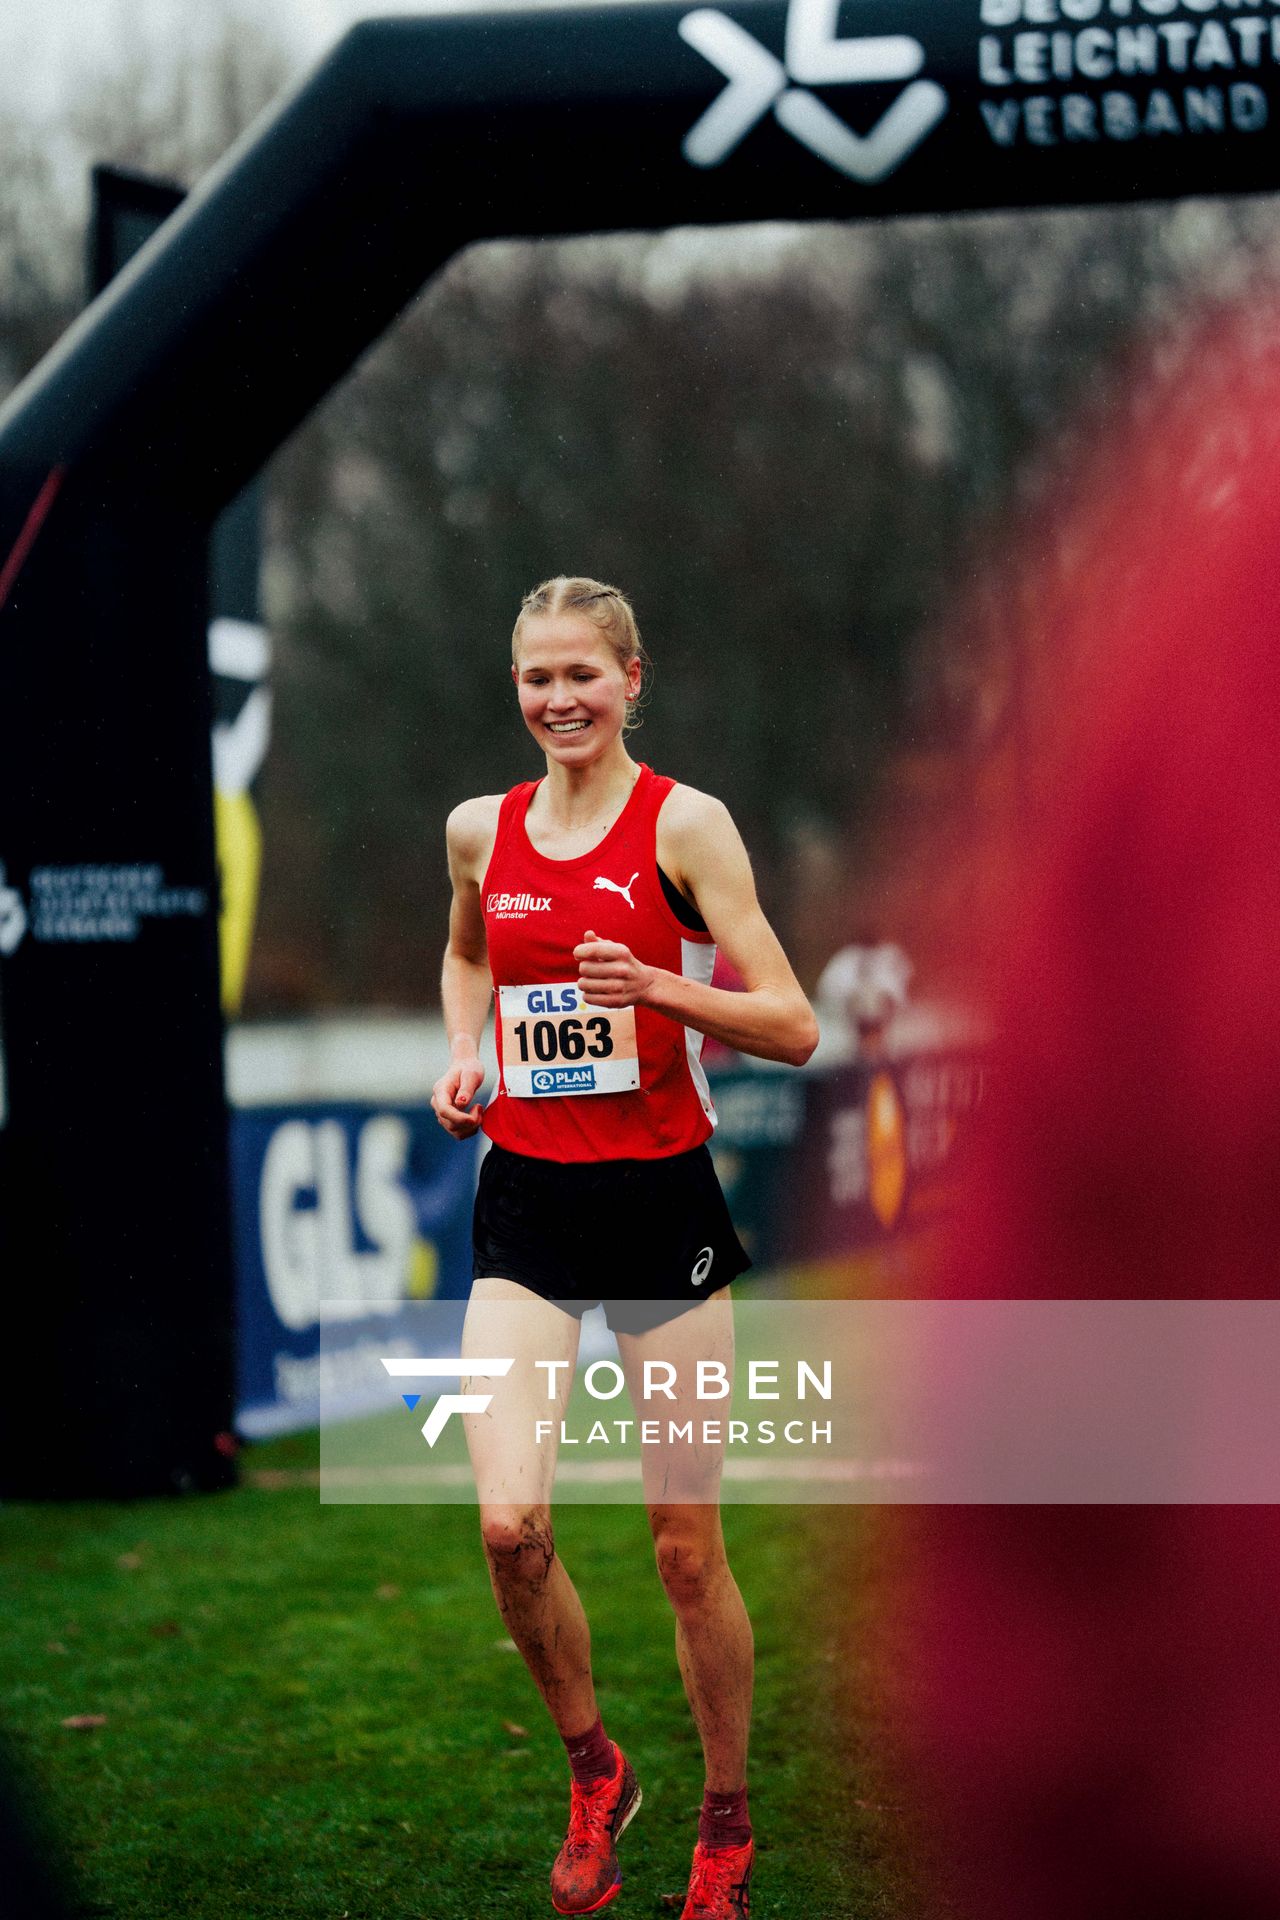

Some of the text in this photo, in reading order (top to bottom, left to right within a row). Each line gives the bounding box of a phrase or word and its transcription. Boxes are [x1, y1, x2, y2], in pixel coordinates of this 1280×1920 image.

[979, 15, 1280, 86] LEICHTAT
[979, 81, 1270, 146] VERBAND
[496, 911, 528, 919] Münster
[498, 893, 552, 911] Brillux
[527, 989, 577, 1013] GLS
[514, 1017, 613, 1062] 1063
[555, 1071, 592, 1083] PLAN
[259, 1115, 415, 1331] GLS
